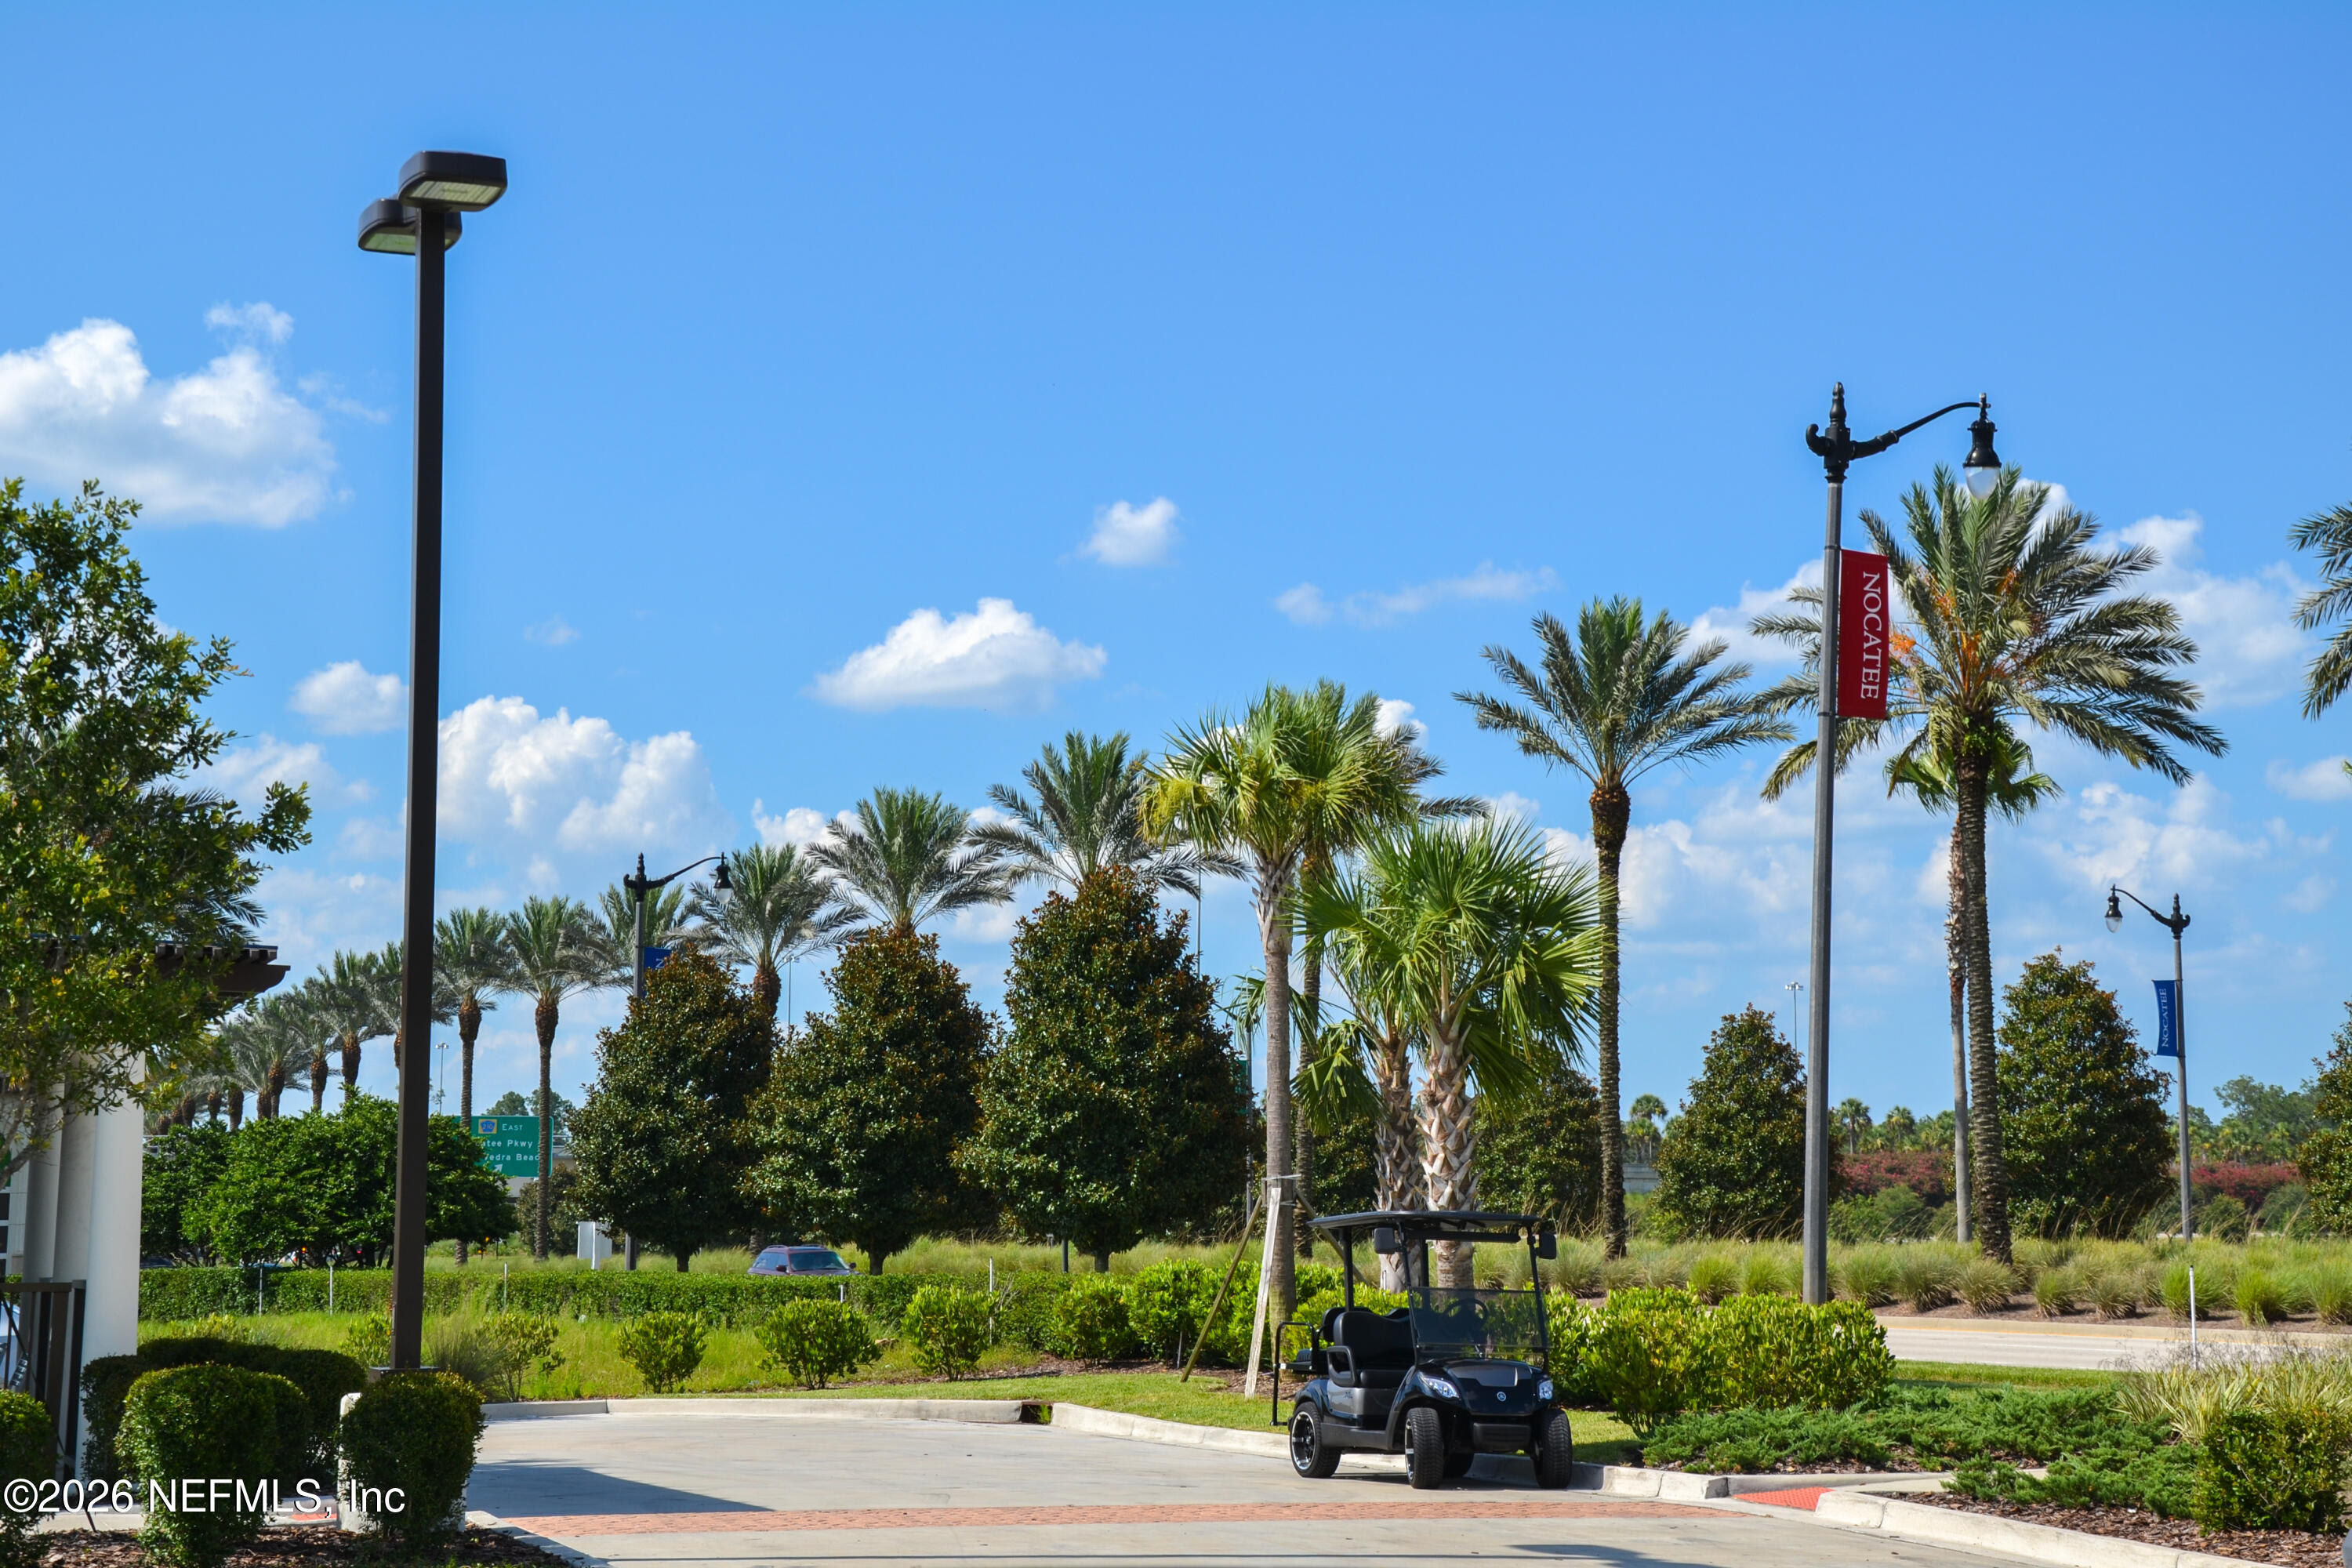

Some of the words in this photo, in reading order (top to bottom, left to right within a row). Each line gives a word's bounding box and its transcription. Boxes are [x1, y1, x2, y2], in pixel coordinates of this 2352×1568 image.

[1860, 572, 1882, 699] NOCATEE
[2159, 989, 2169, 1047] NOCATEE
[507, 1139, 533, 1149] Pkwy
